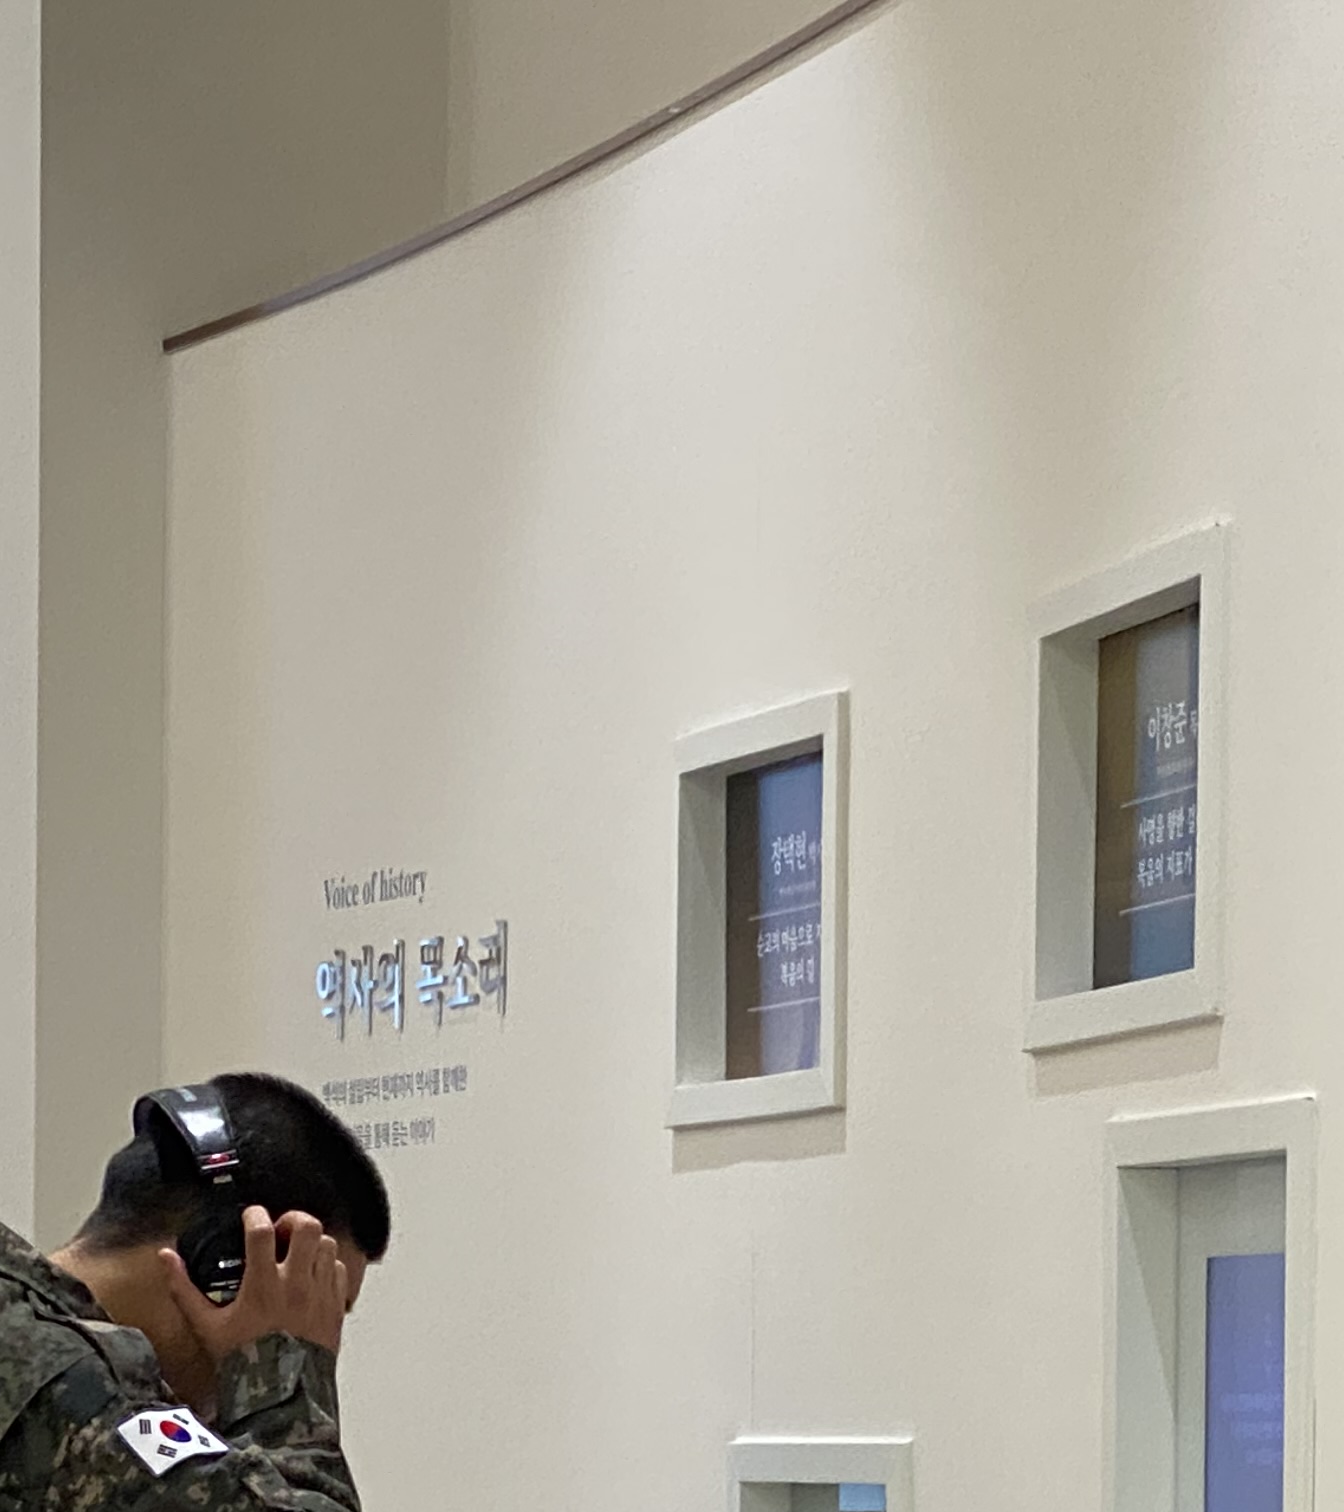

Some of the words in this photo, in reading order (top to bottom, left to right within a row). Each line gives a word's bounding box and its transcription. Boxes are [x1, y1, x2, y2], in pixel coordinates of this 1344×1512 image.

[324, 878, 359, 910] Voice
[363, 870, 377, 904] of
[380, 867, 428, 904] history
[1136, 854, 1164, 888] 복음의
[316, 938, 405, 1042] 역사의
[416, 919, 507, 1029] 목소리
